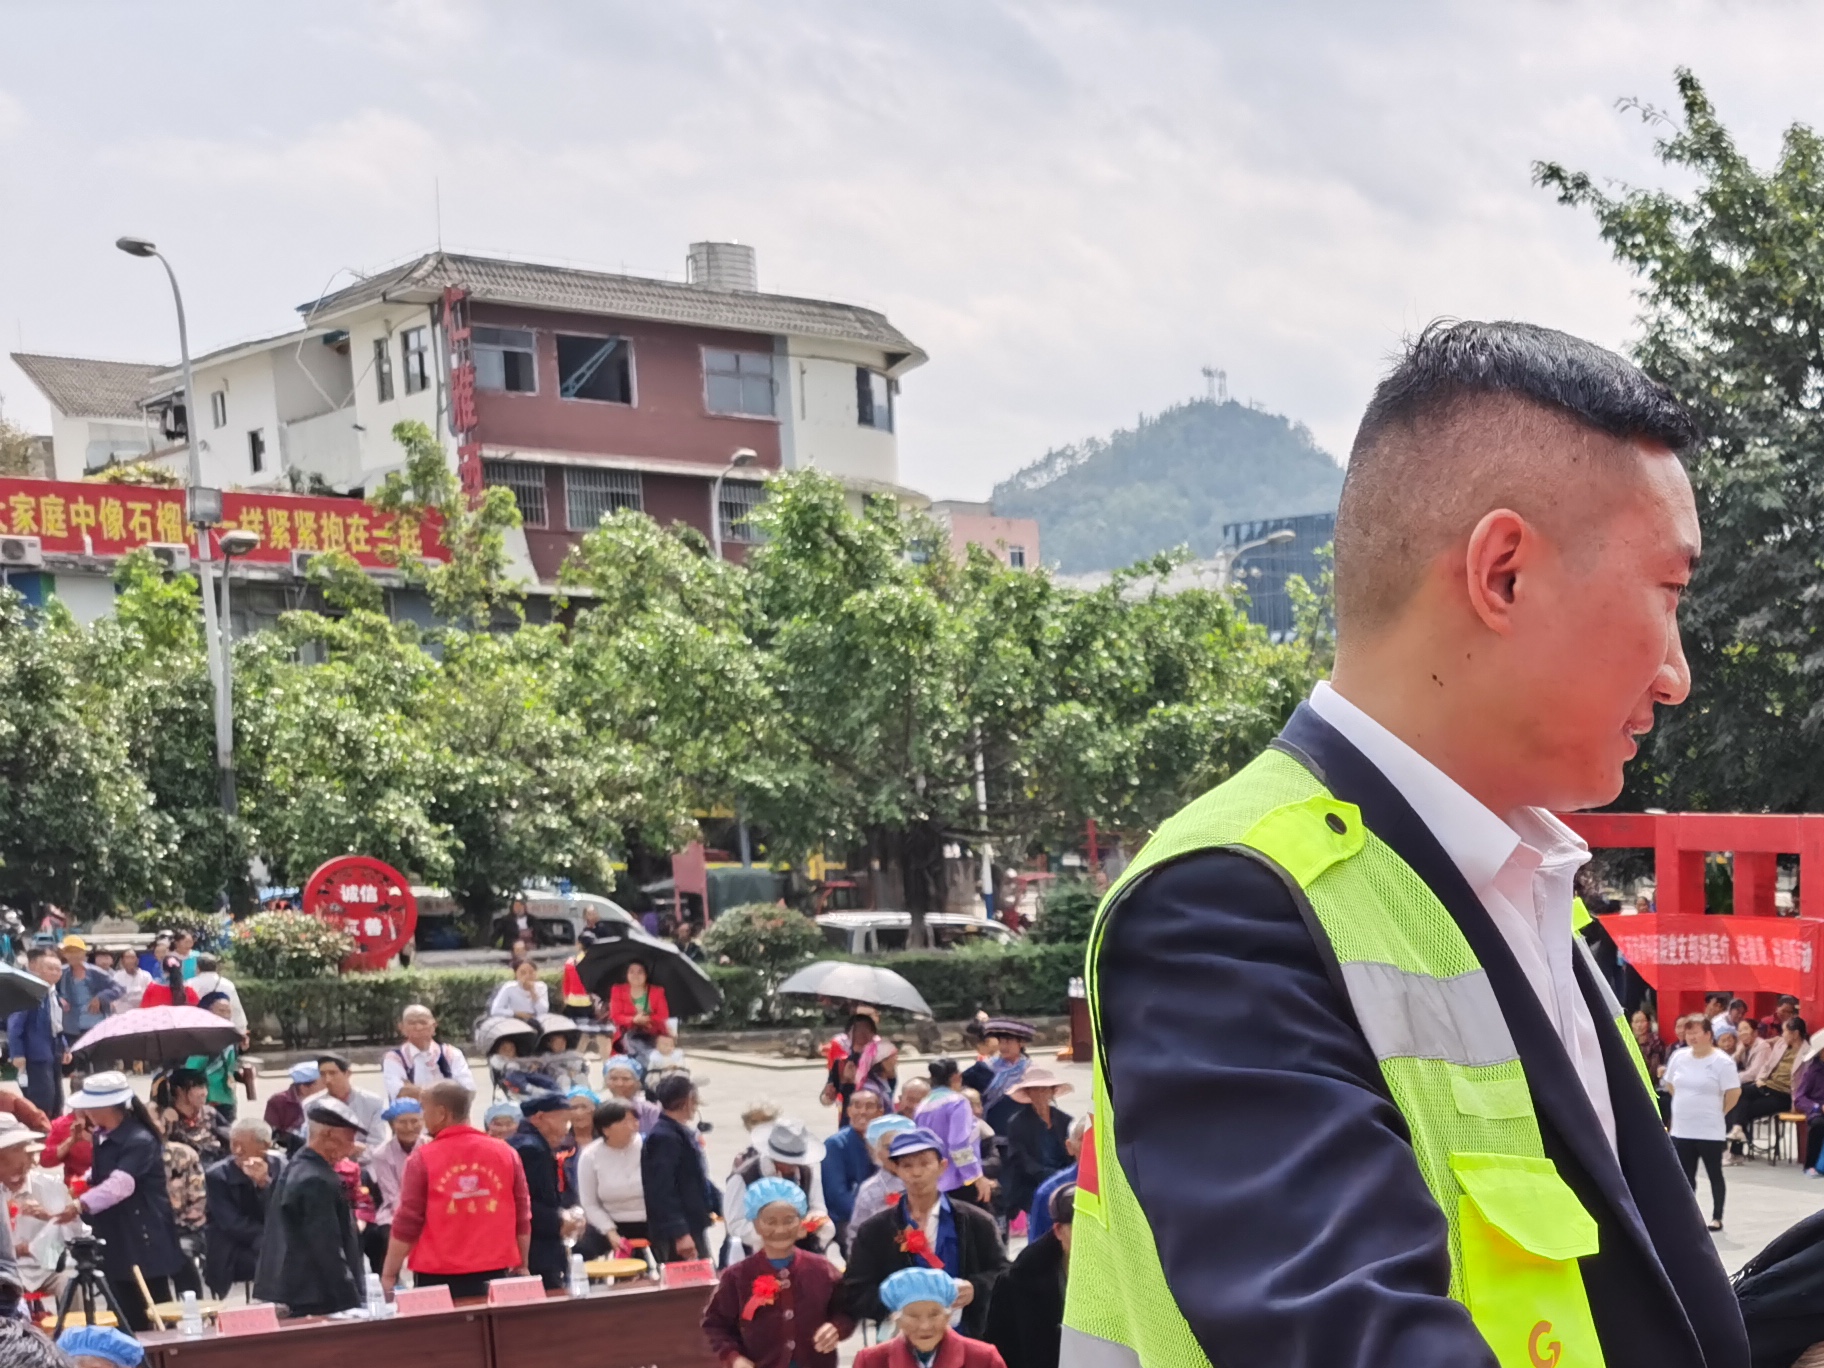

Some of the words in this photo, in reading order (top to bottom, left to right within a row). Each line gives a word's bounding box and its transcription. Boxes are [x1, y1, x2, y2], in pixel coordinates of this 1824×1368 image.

[0, 492, 423, 556] 家庭中像石榴一样紧紧抱在一起
[340, 884, 378, 903] 诚信
